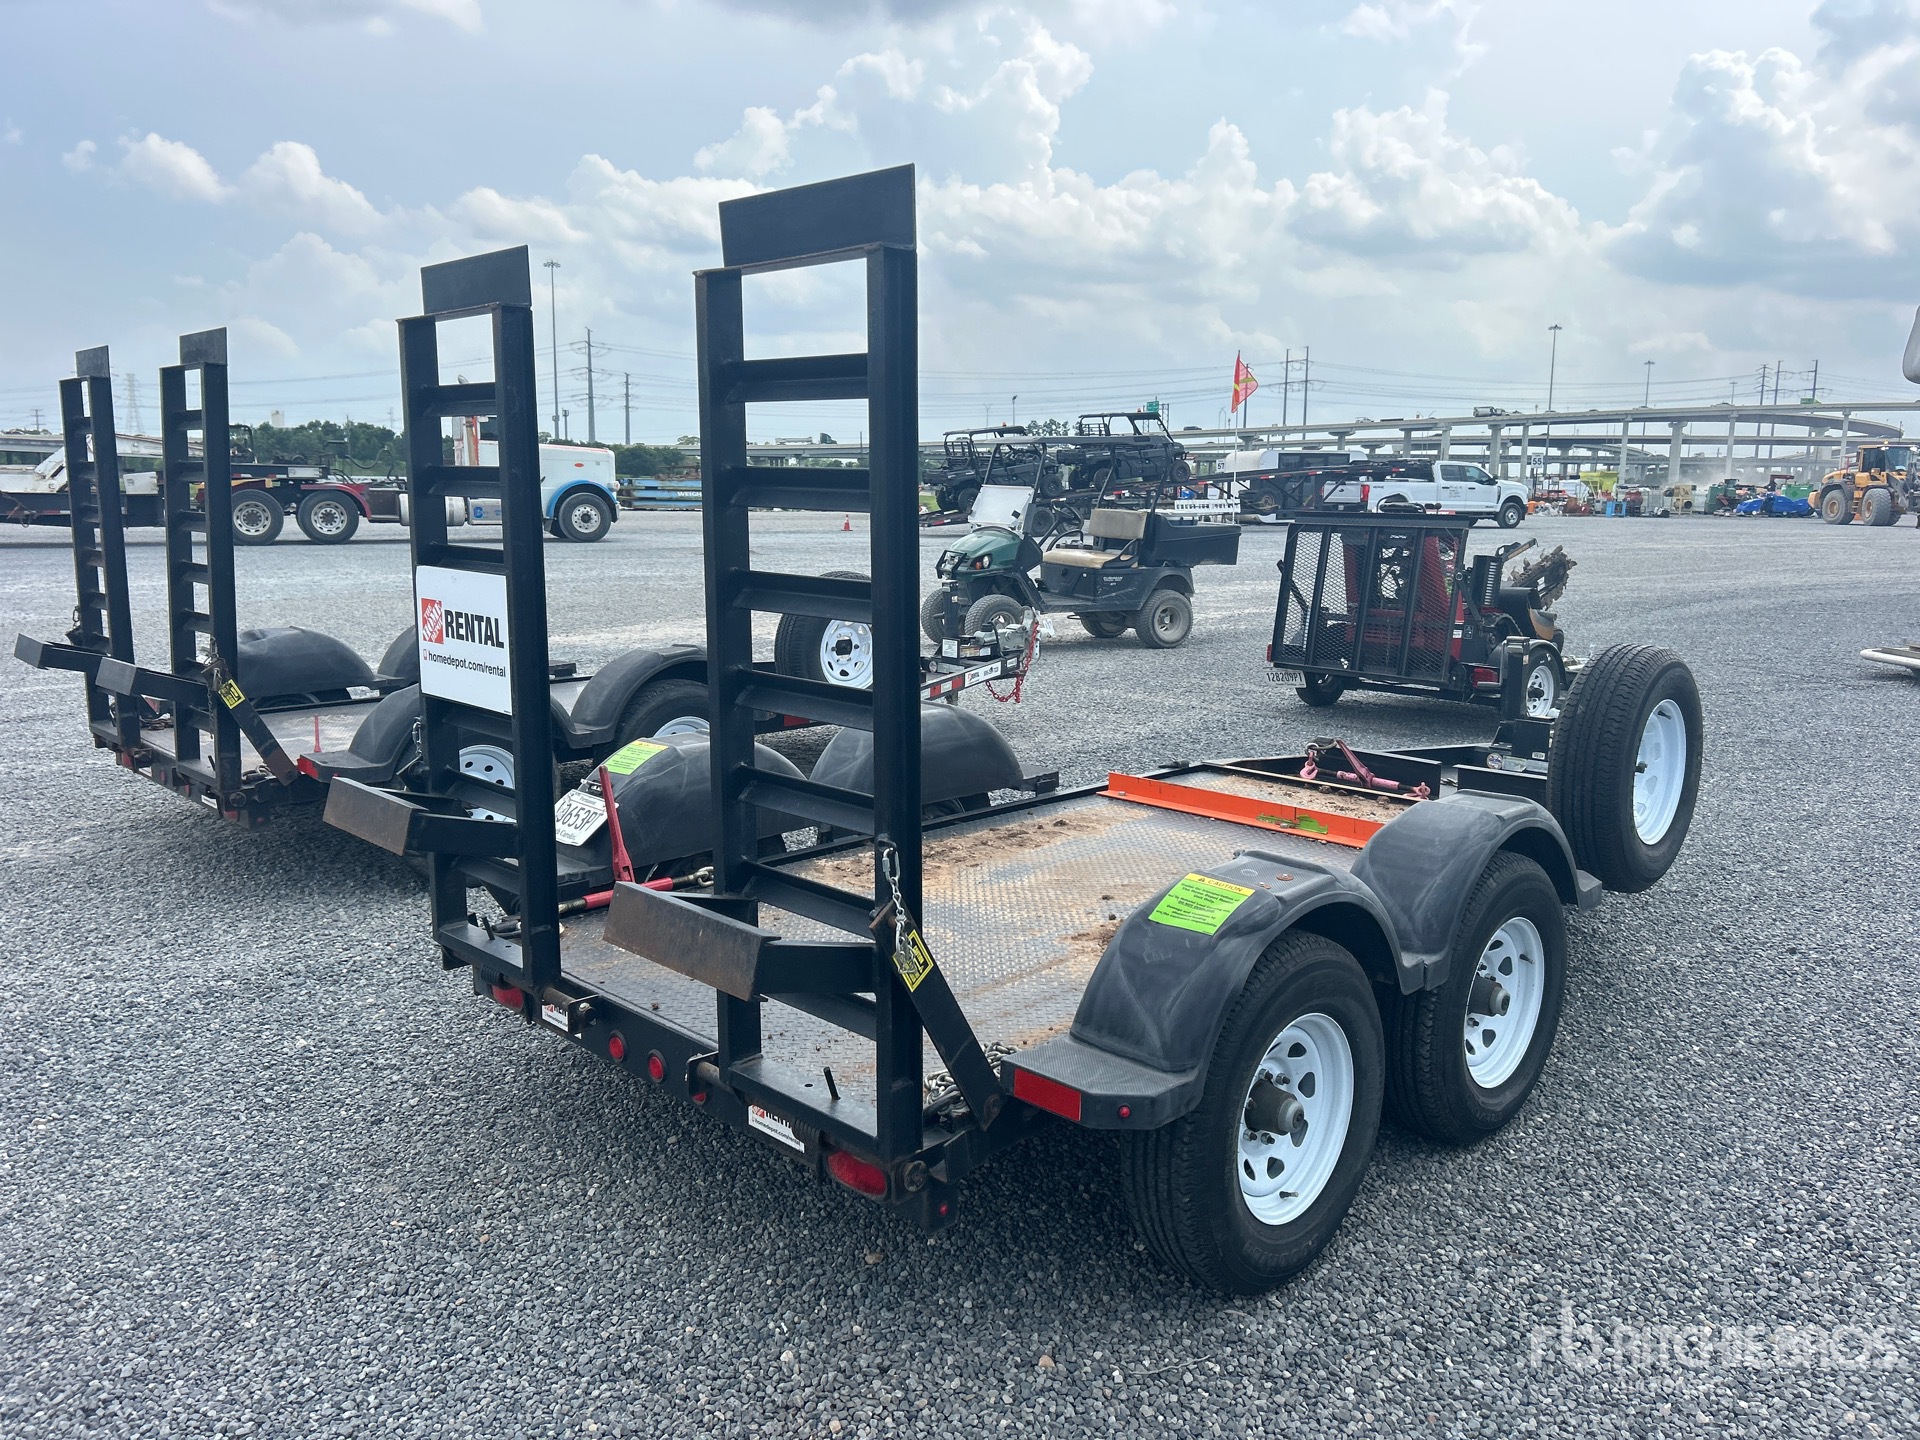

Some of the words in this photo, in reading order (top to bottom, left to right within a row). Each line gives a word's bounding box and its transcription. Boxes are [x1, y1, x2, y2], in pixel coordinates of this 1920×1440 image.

[1532, 457, 1542, 465] 55
[444, 609, 504, 649] RENTAL
[428, 650, 506, 678] homedepot.com/rental
[1208, 880, 1243, 892] CAUTION
